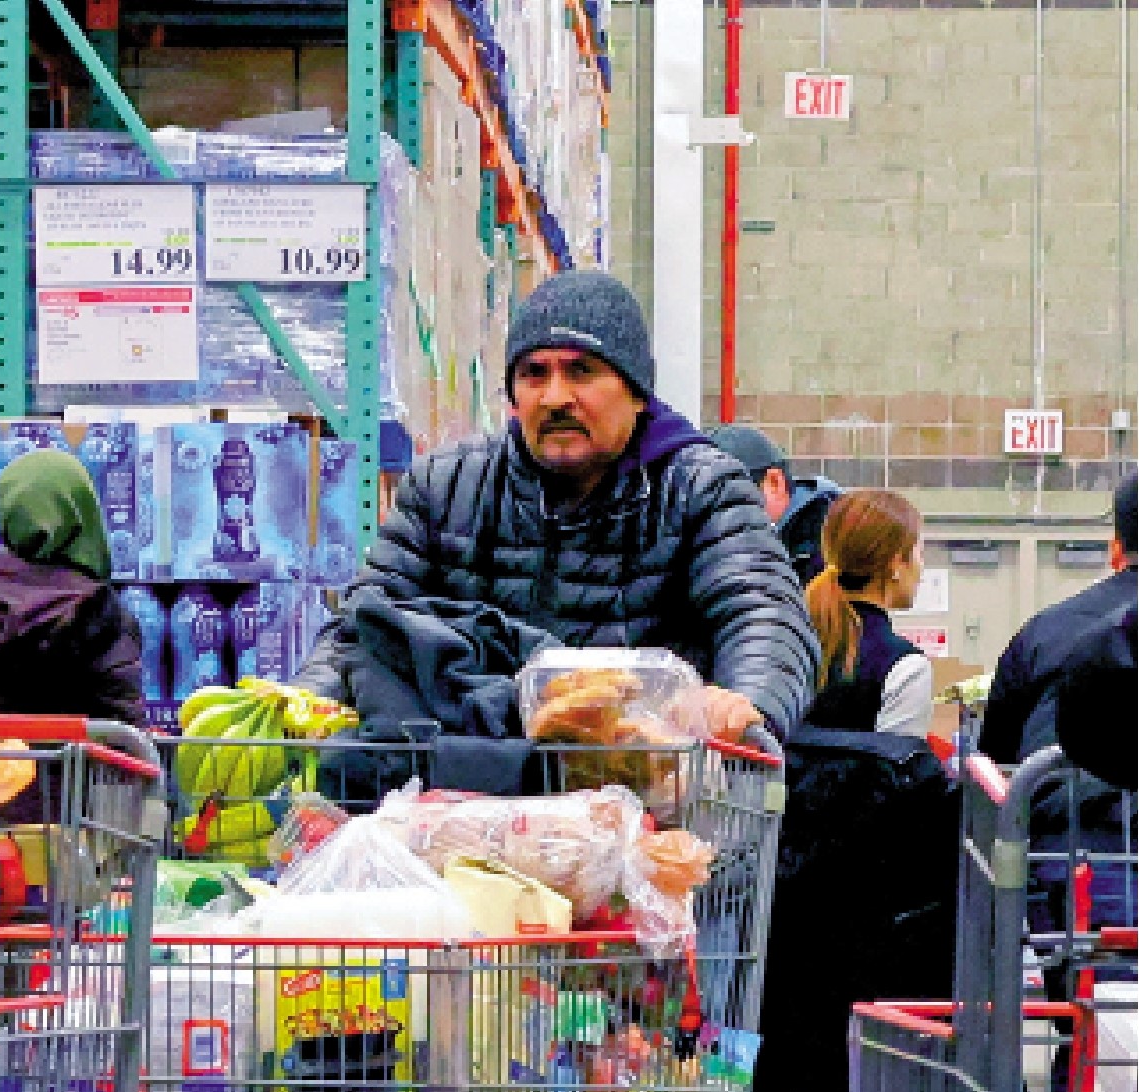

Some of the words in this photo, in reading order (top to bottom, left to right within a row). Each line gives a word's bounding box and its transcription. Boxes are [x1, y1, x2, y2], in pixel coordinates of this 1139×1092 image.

[794, 77, 847, 116] EXIT
[111, 247, 193, 275] 14.99
[279, 247, 361, 274] 10.99
[1010, 416, 1060, 450] EXIT
